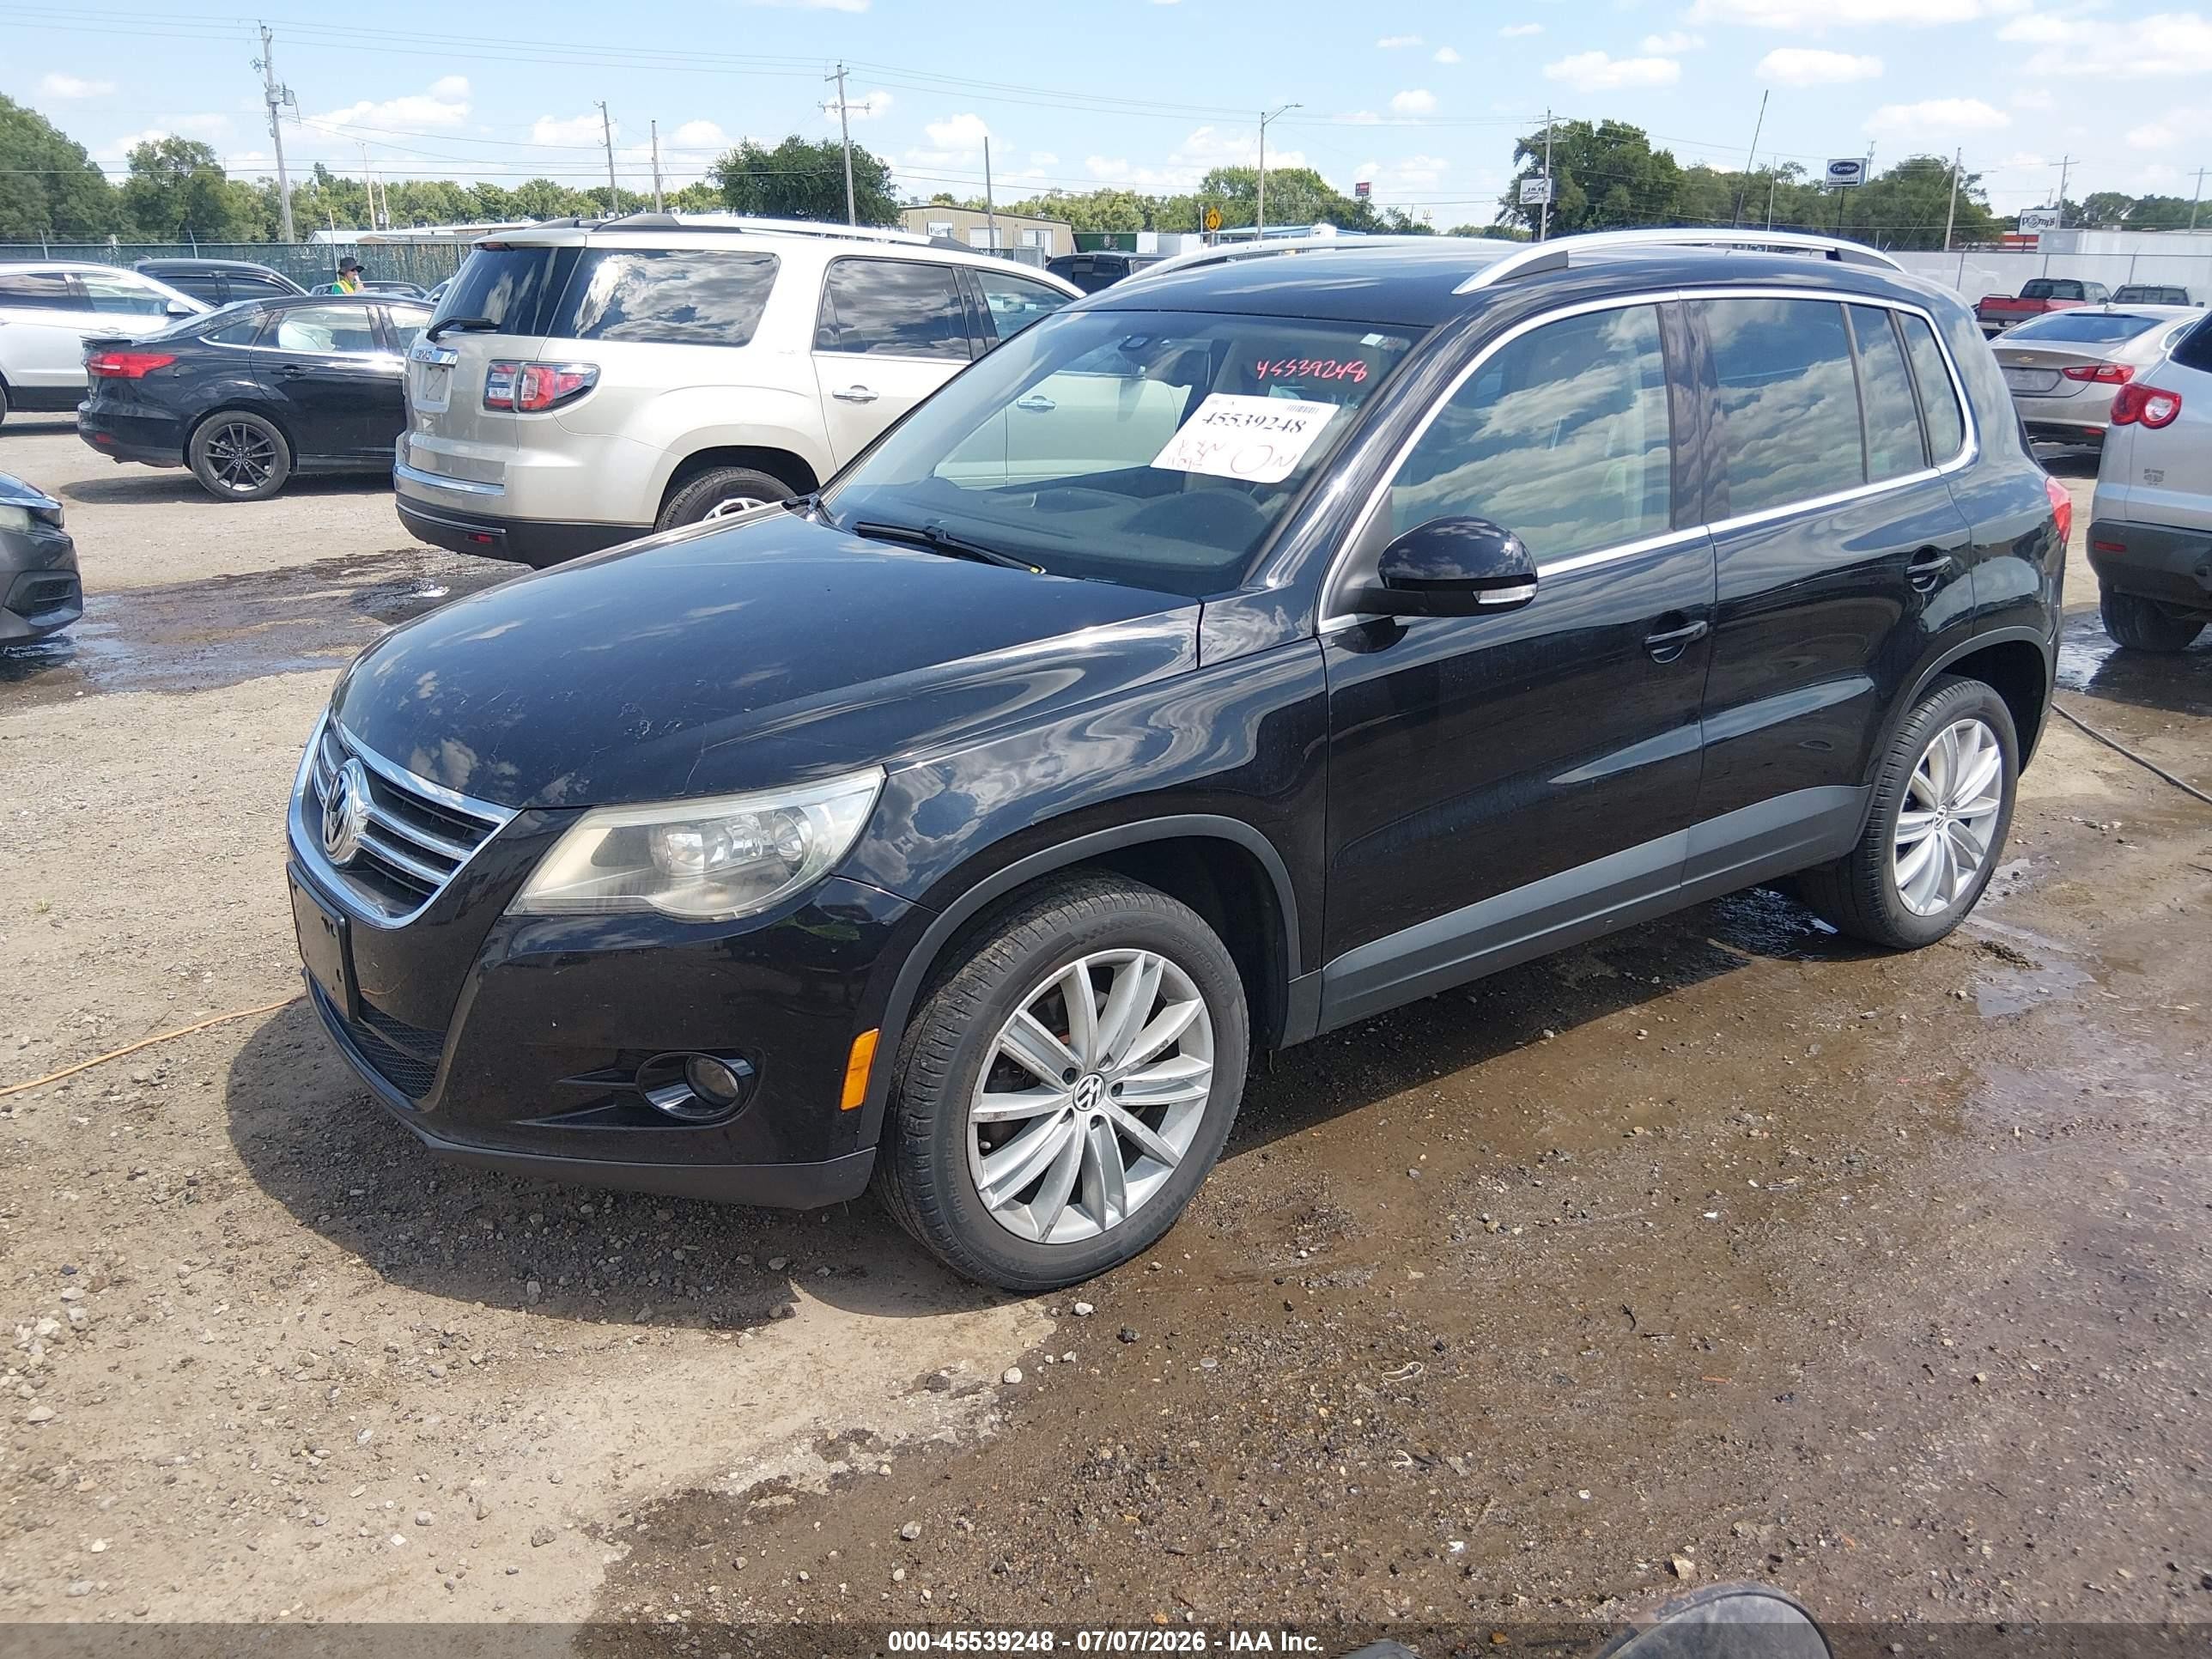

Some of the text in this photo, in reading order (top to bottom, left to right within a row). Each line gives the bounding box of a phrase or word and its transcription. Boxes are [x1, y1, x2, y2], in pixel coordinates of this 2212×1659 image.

[1832, 164, 1858, 173] Carrier
[1256, 359, 1368, 383] 45539248
[1202, 411, 1307, 433] 45539248
